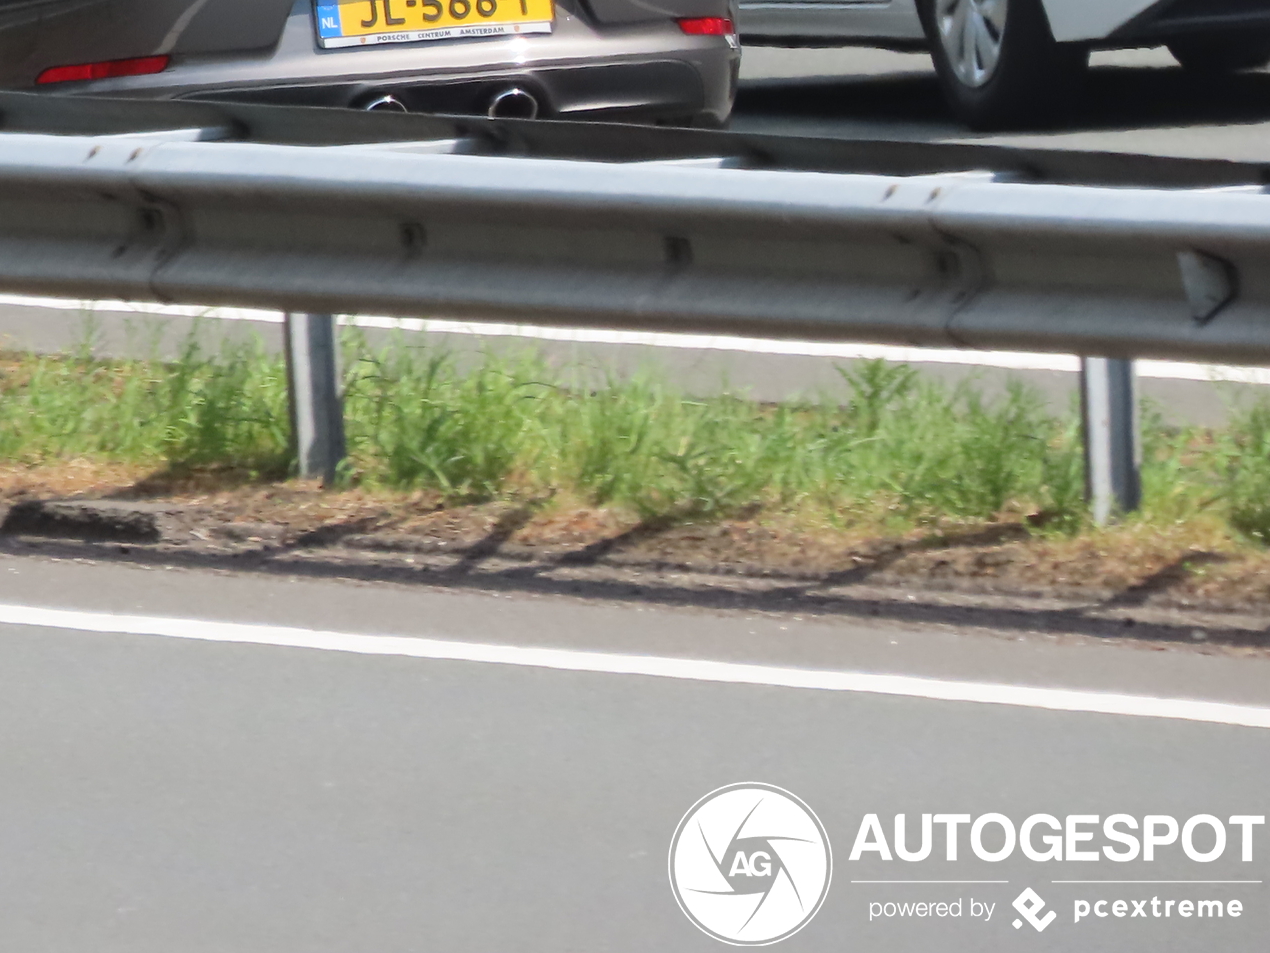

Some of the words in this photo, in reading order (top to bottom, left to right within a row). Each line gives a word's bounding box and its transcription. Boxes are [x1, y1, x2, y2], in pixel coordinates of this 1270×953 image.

[322, 17, 338, 30] NL
[377, 33, 411, 42] PORSCHE
[417, 30, 452, 39] CENTRUM
[459, 26, 505, 35] AMSTERDAM
